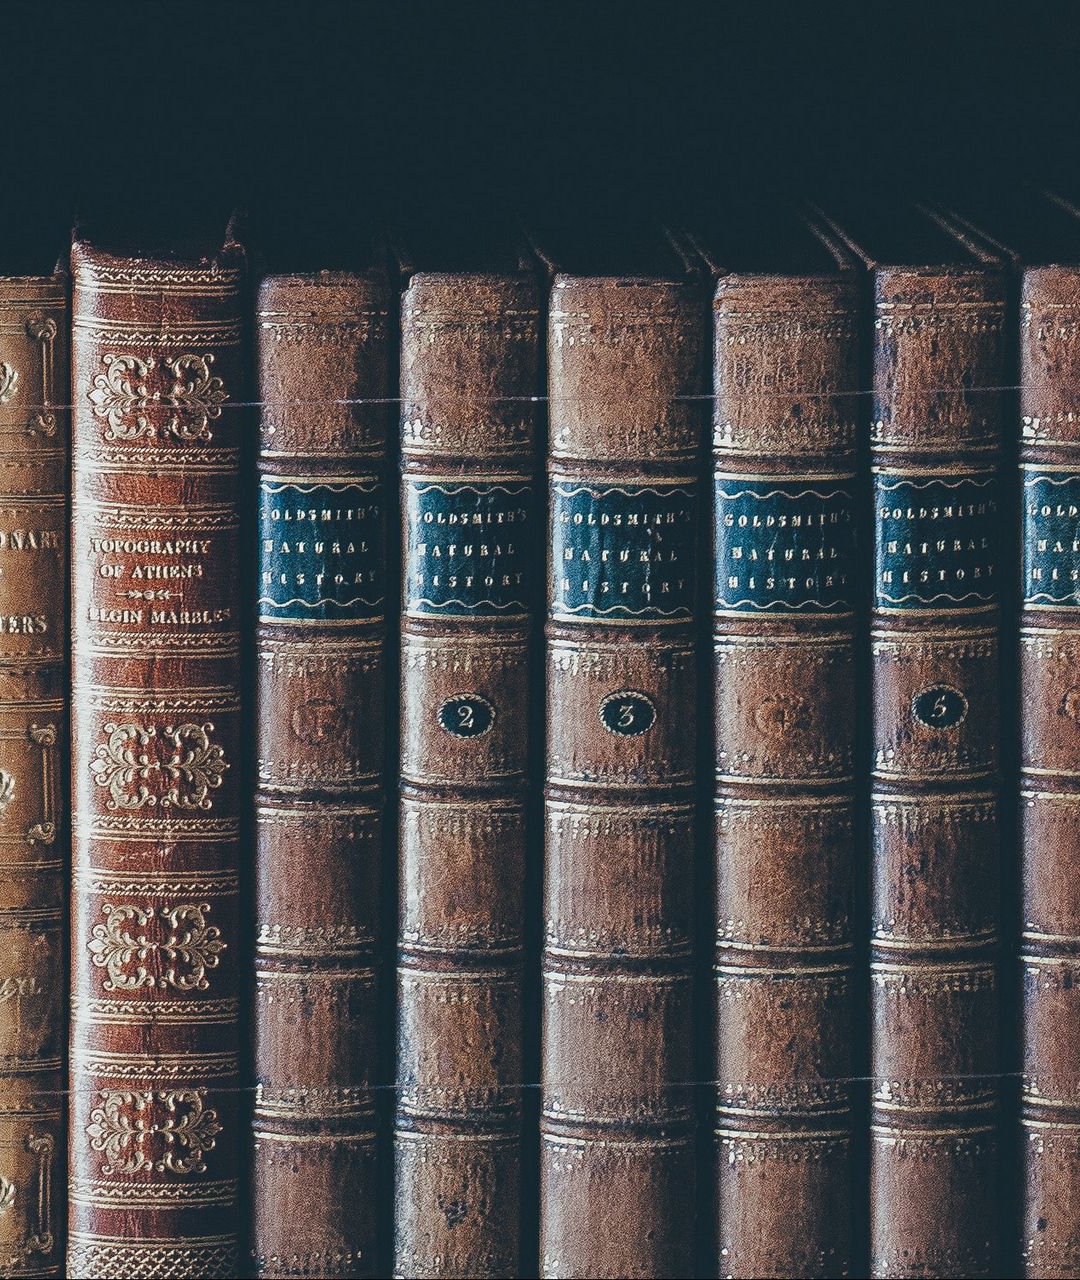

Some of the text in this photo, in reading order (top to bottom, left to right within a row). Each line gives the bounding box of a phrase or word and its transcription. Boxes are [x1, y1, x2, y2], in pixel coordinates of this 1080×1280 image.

[91, 537, 211, 555] TOPOGRAPHY
[264, 540, 369, 555] NATURAL
[417, 543, 516, 558] NATURAL
[731, 545, 838, 562] NATURAL
[888, 538, 988, 556] NATURAL
[564, 548, 678, 564] NATURAL
[99, 564, 203, 579] OF ATHENS
[262, 570, 376, 586] HISTORY
[883, 564, 994, 583] HISTORY
[561, 579, 685, 594] HISTORY
[728, 573, 847, 589] HISTORY
[931, 694, 947, 718] 5
[457, 705, 475, 728] 2
[619, 704, 634, 726] 3
